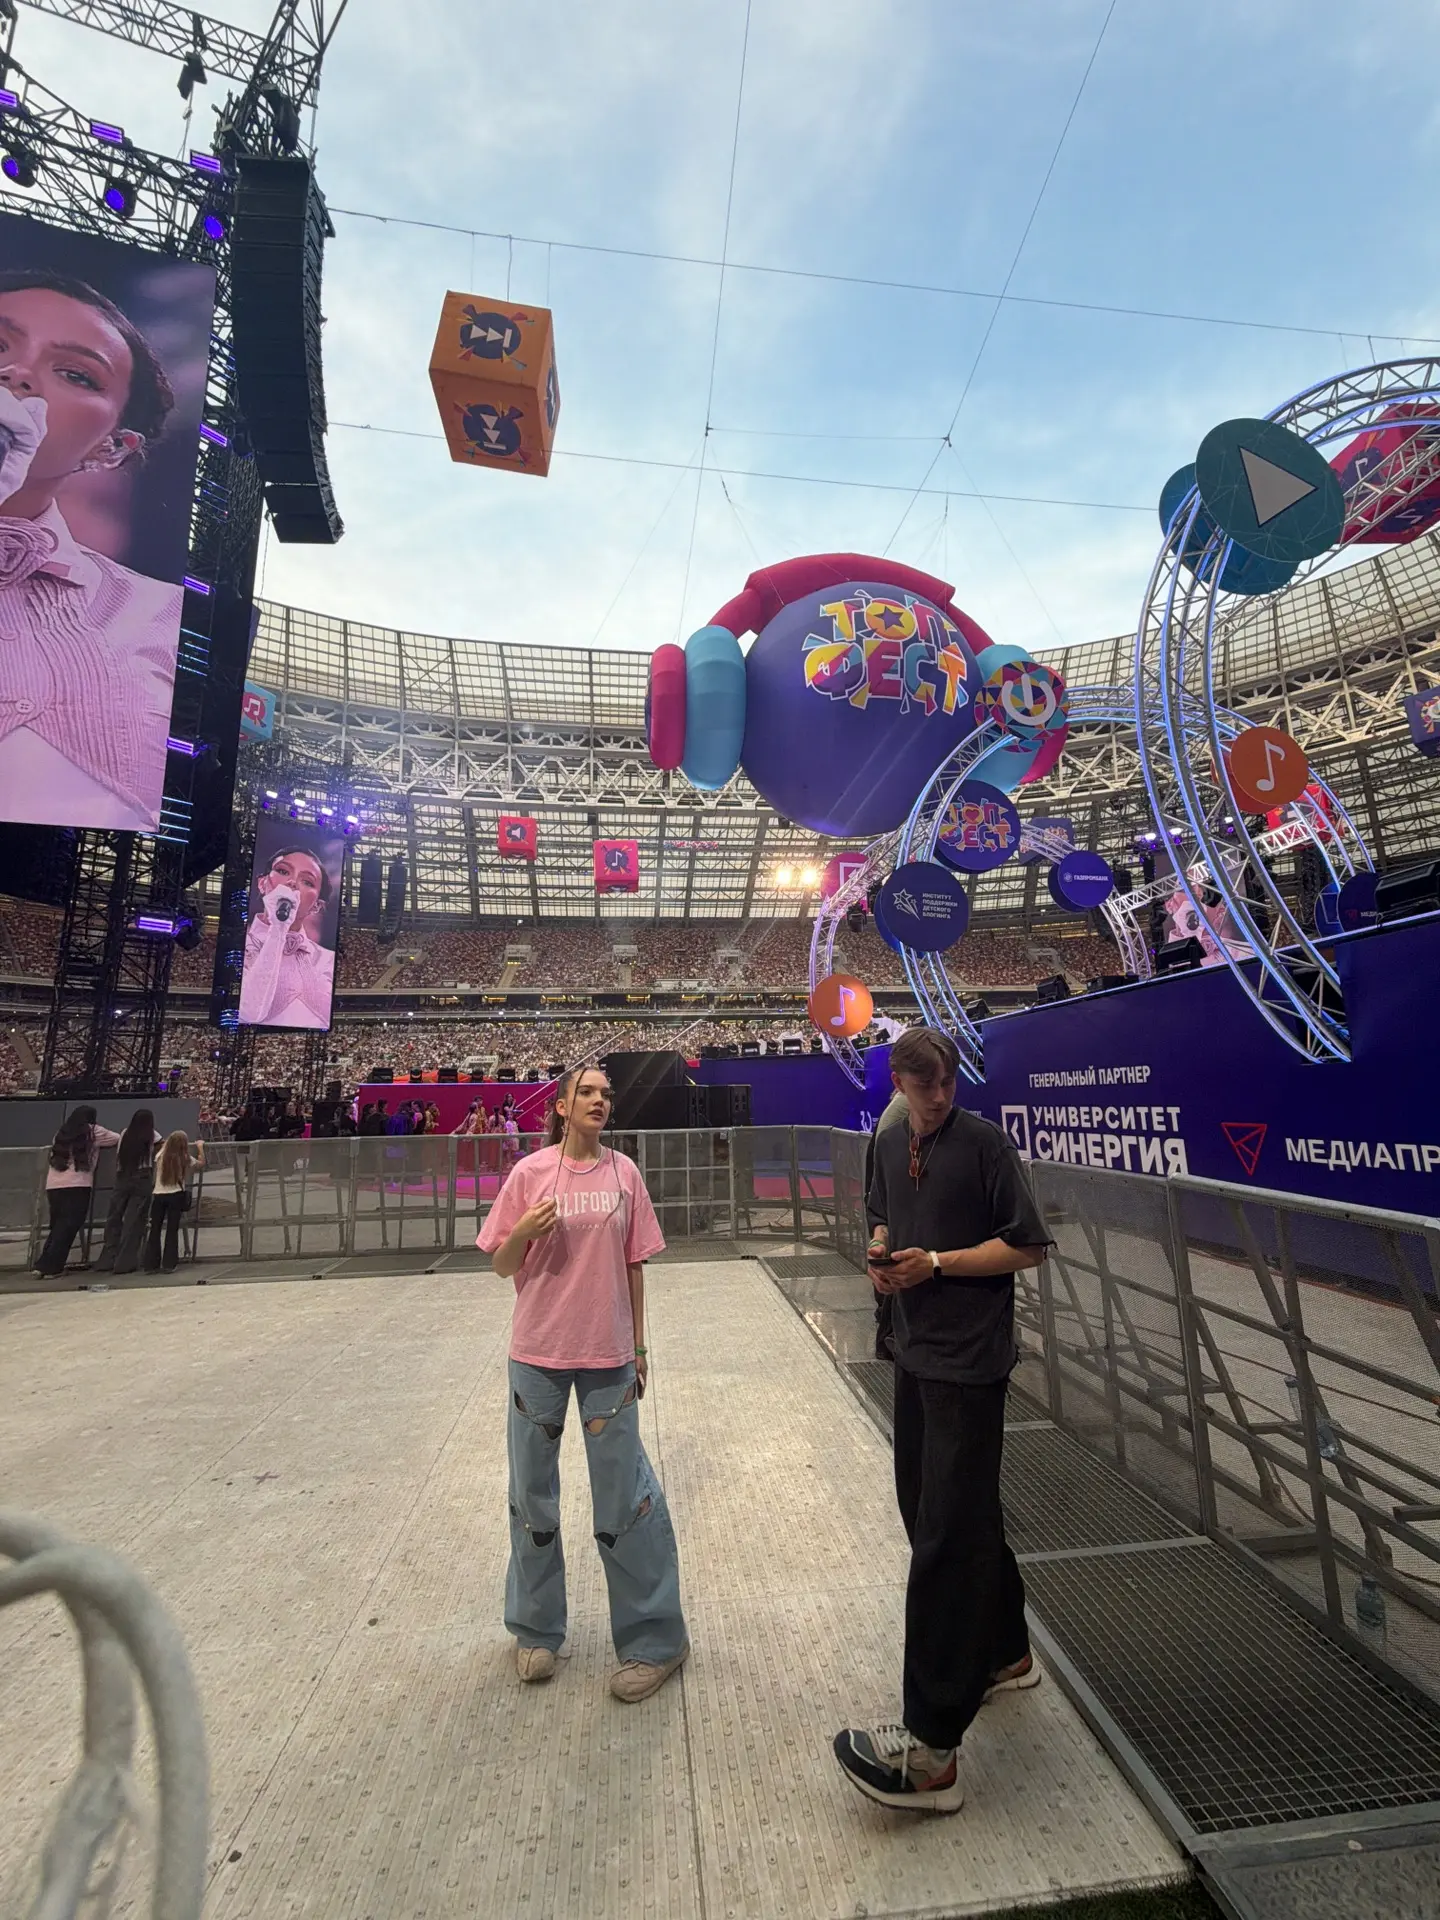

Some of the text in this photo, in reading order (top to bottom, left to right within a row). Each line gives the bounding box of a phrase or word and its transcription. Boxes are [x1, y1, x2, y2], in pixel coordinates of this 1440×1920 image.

[819, 594, 955, 651] ТОП
[804, 641, 968, 715] ФЕСТ
[939, 819, 1014, 851] ФЕСТ
[1073, 874, 1109, 882] ГАЗПРОМБАНК
[922, 892, 952, 900] ИНСТИТУТ
[922, 898, 958, 907] ПОДДЕРЖКИ
[1029, 1065, 1151, 1088] ГЕНЕРАЛЬНЫЙ ПАРТНЕР
[1032, 1106, 1181, 1132] УНИВЕРСИТЕТ
[1035, 1130, 1189, 1175] СИНЕРГИЯ
[1285, 1137, 1440, 1173] МЕДИАПР
